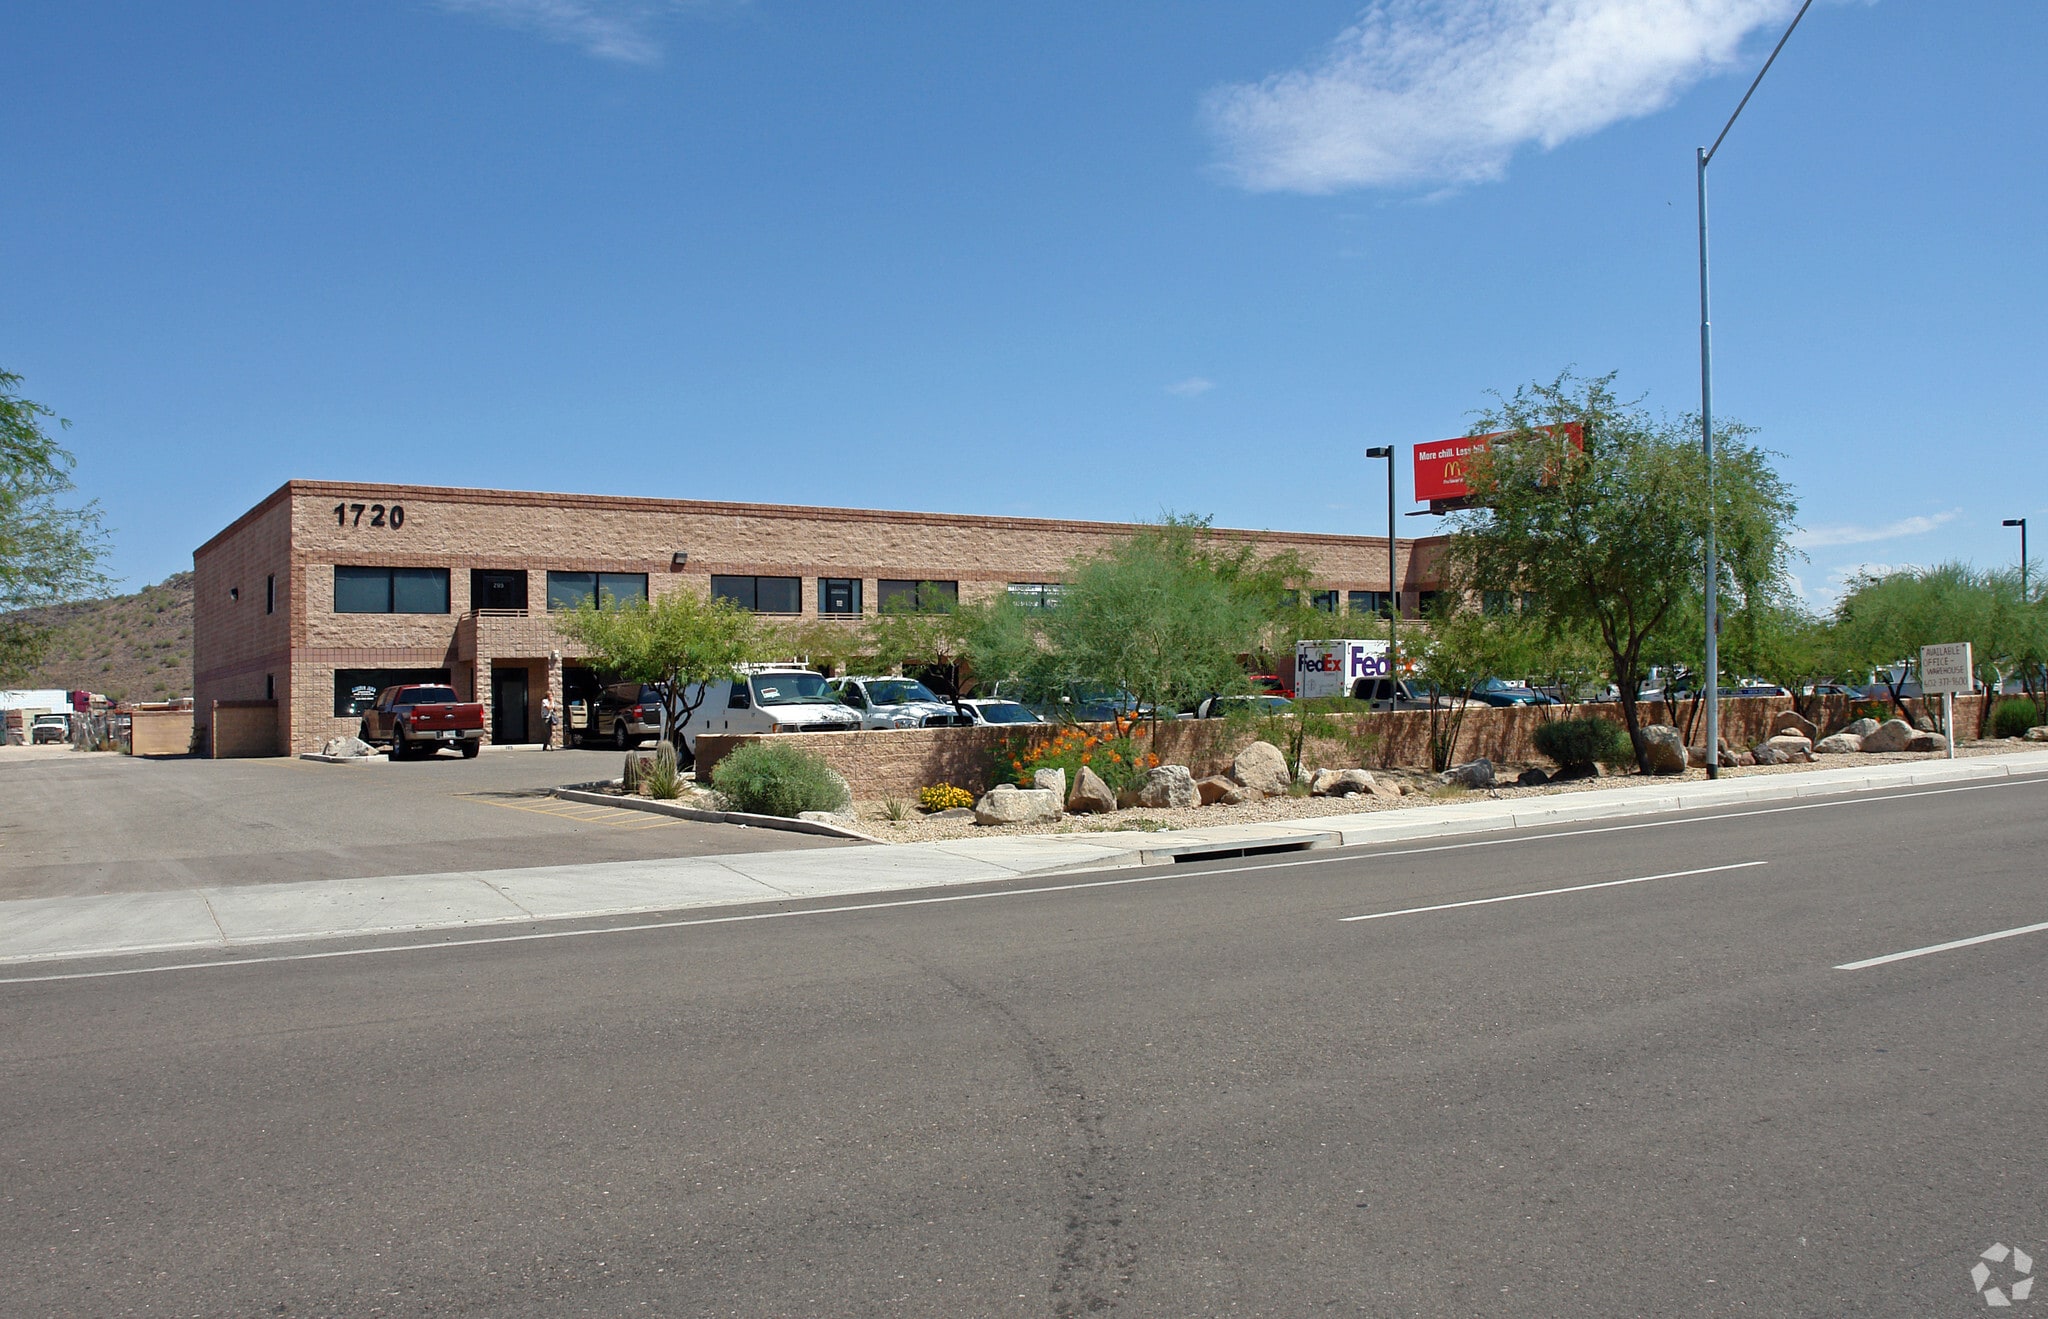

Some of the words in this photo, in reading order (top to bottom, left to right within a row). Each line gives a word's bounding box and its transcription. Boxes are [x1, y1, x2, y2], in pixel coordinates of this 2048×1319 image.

[1419, 451, 1437, 461] More
[1438, 448, 1455, 459] chill.
[333, 502, 405, 530] 1720
[1926, 646, 1960, 656] AVAILABLE
[1298, 653, 1342, 672] FedEx
[1927, 665, 1964, 675] WAREHOUSE
